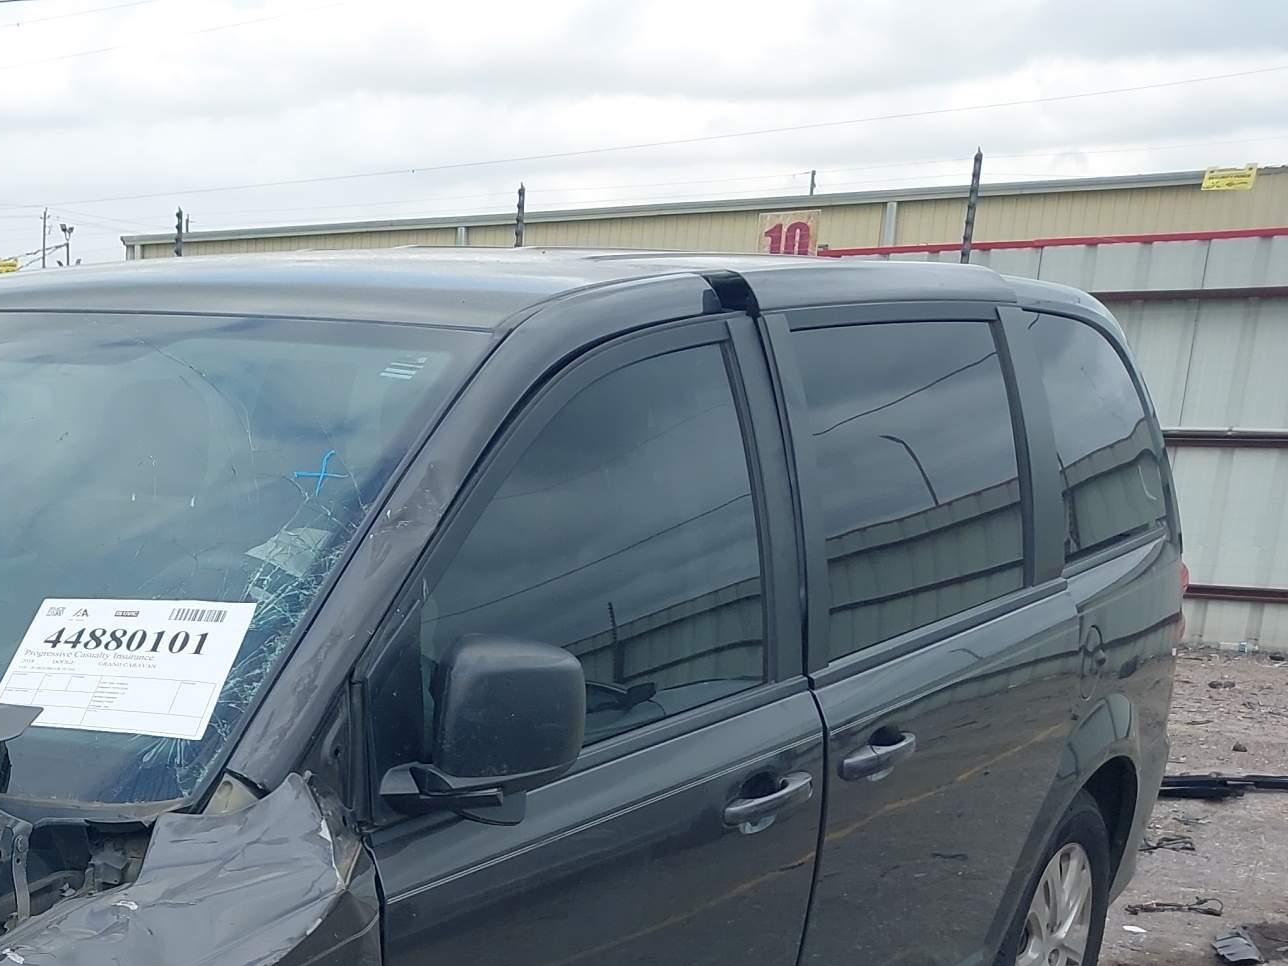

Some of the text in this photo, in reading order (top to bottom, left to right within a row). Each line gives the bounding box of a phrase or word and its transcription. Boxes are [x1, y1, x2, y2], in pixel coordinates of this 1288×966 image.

[764, 221, 810, 255] 10
[23, 648, 156, 661] Progressive Casualty Insurance
[43, 627, 209, 655] 44880101
